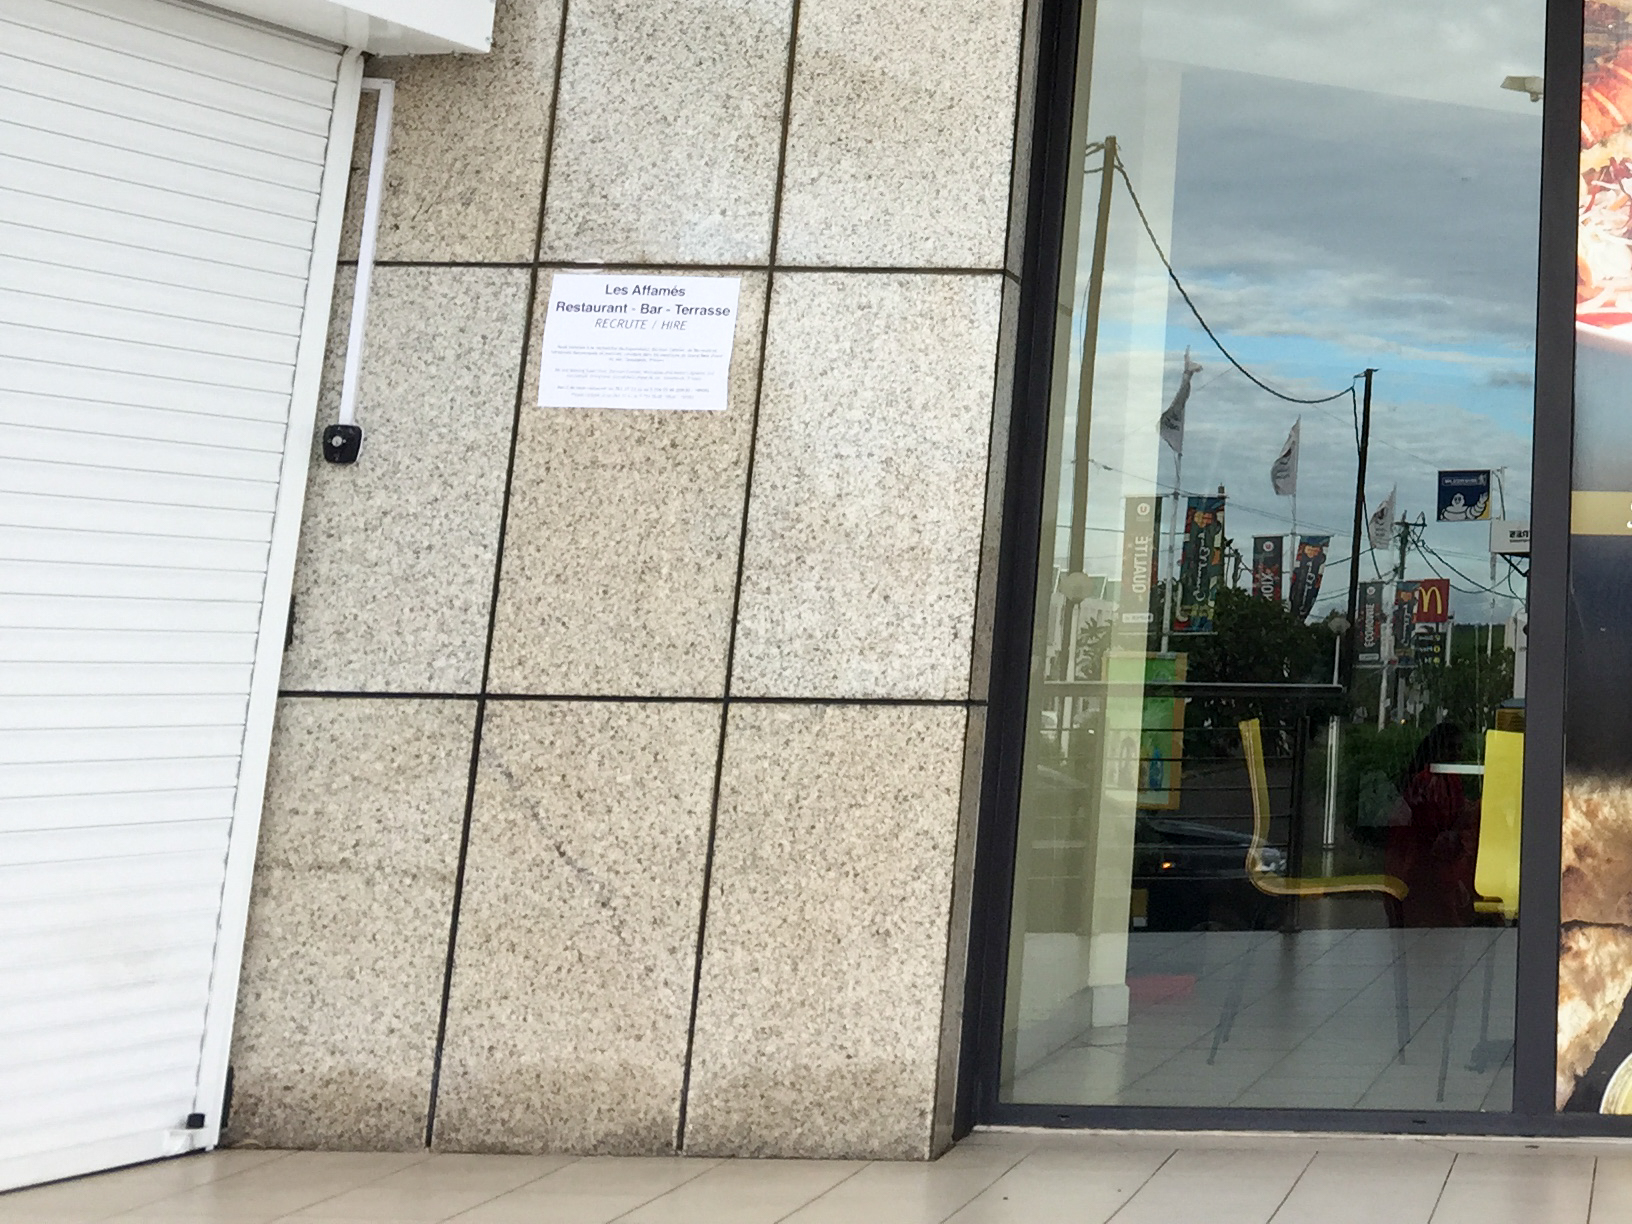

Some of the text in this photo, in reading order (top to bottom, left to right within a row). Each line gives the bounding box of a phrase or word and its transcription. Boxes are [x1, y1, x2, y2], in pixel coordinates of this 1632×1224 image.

[605, 284, 686, 297] Les Affamés
[555, 301, 628, 314] Restaurant
[640, 303, 663, 315] Bar
[675, 304, 730, 316] Terrasse
[594, 318, 648, 330] RECRUTE
[661, 320, 688, 331] HIRE
